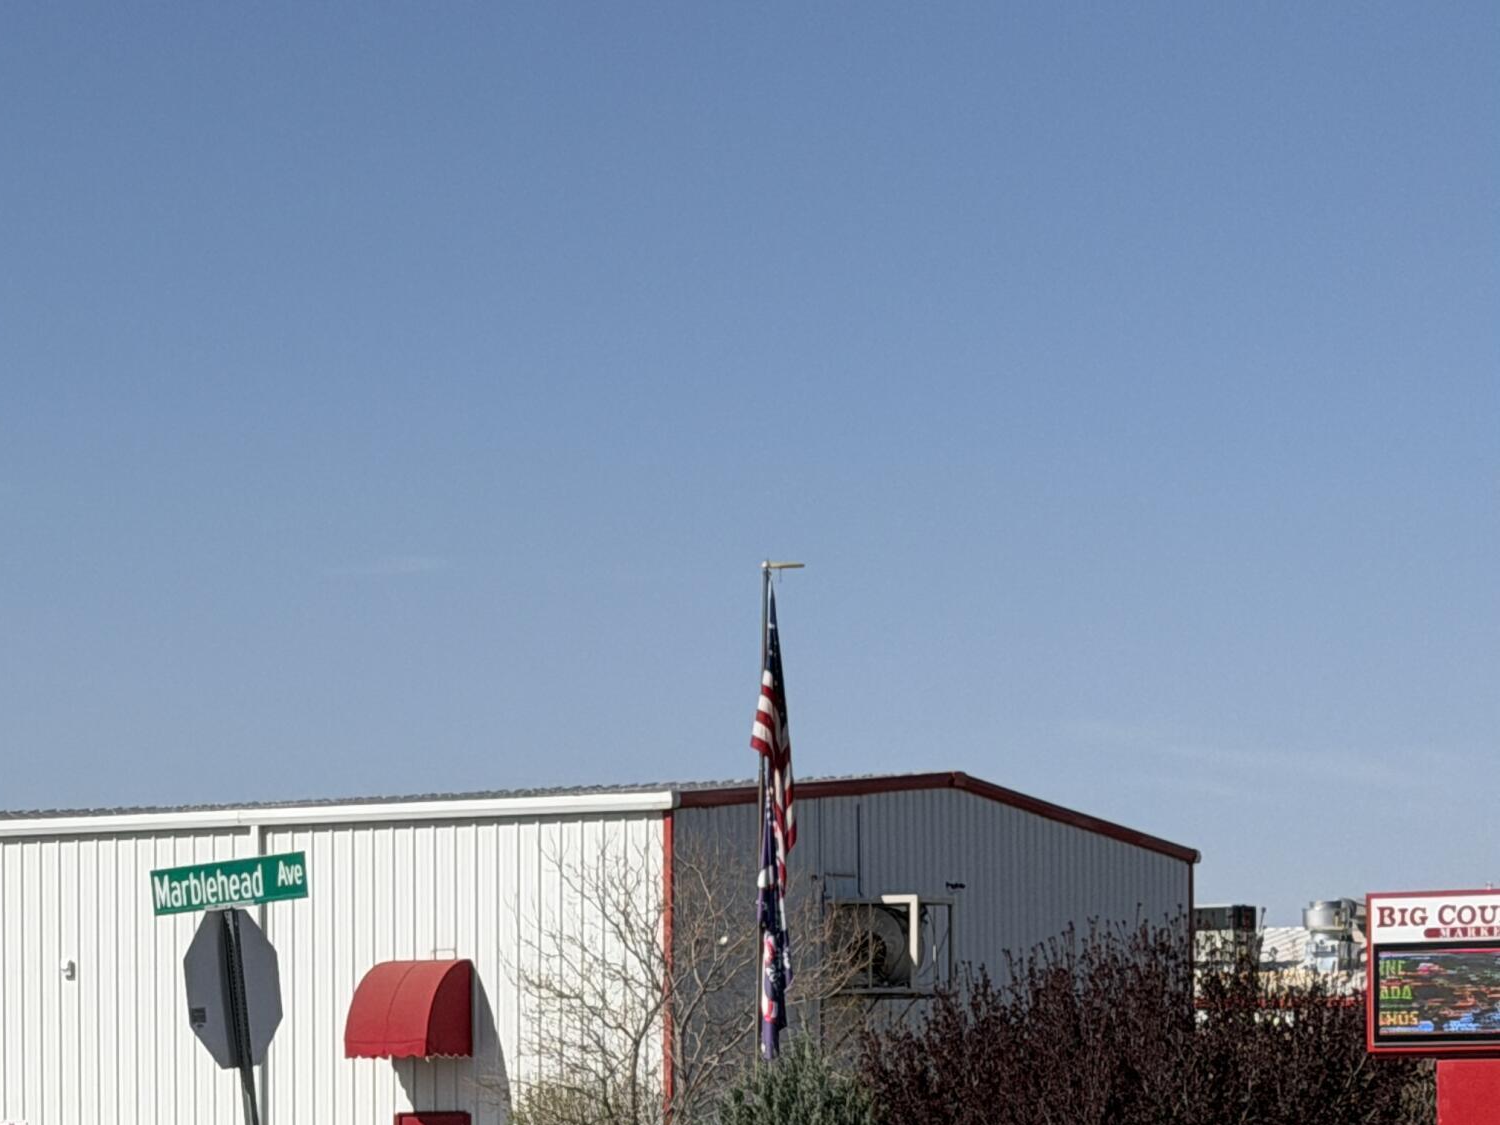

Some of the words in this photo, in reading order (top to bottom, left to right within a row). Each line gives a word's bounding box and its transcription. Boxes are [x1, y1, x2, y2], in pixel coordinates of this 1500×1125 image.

[154, 863, 264, 909] Marblehead
[277, 860, 303, 887] Ave
[1377, 906, 1428, 928] BIG
[1438, 904, 1500, 925] COU
